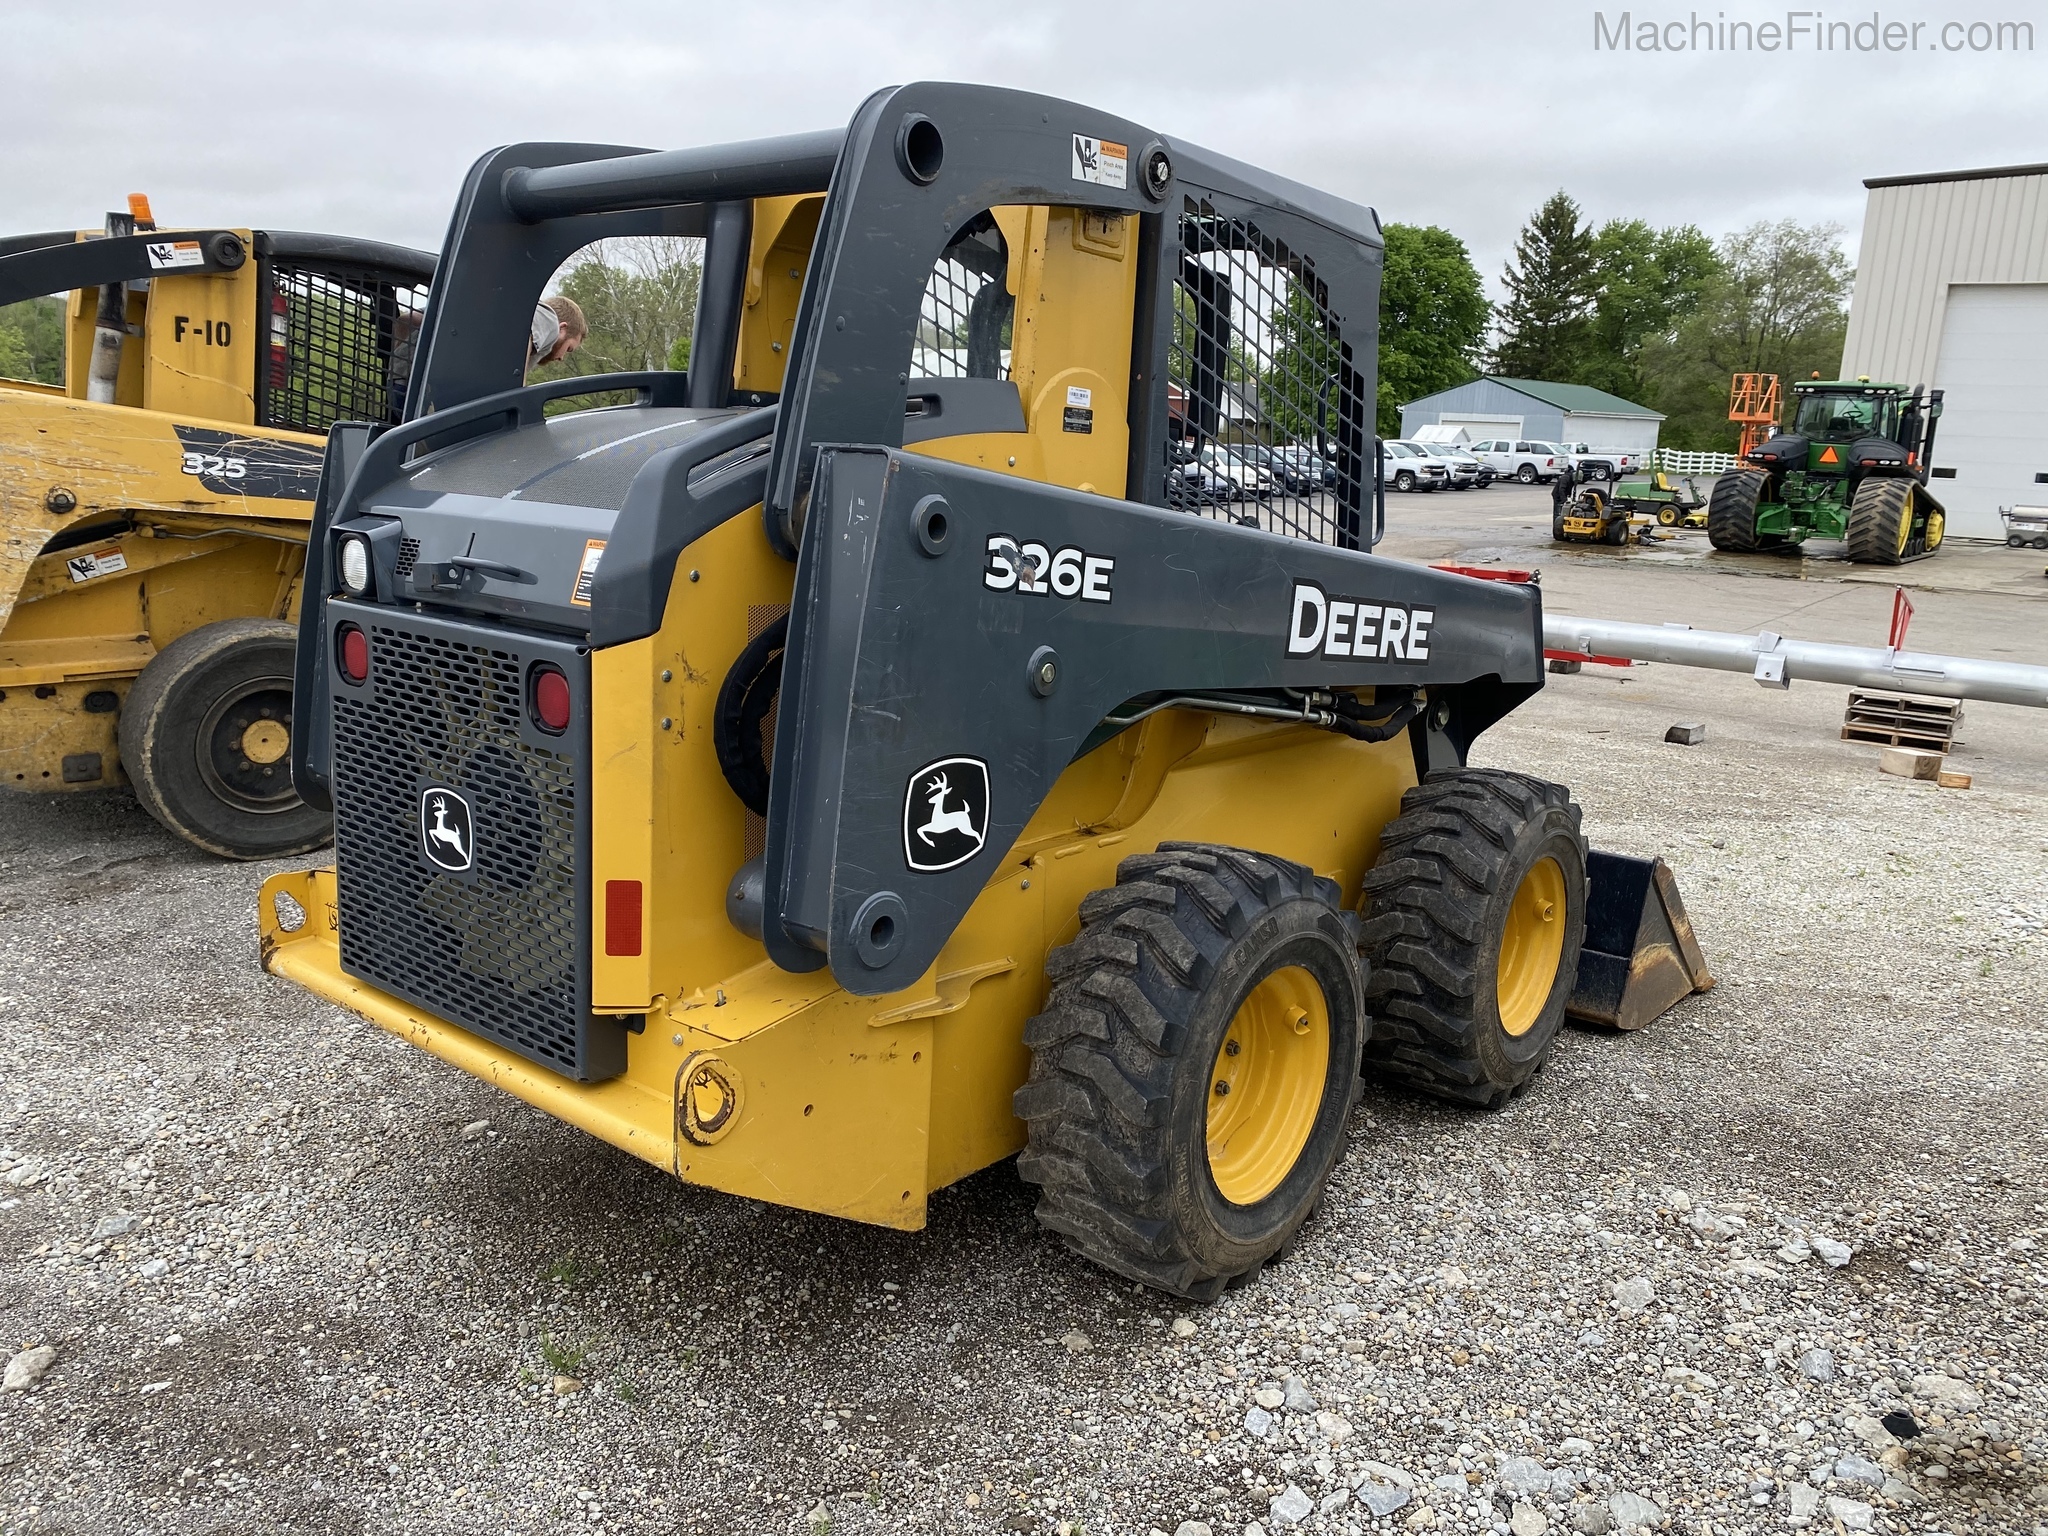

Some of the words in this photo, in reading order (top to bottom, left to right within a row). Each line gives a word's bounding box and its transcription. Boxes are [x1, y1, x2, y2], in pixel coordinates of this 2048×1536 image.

[175, 316, 231, 347] F-10
[182, 452, 247, 479] 325
[984, 535, 1115, 602] 326E
[1288, 584, 1434, 660] DEERE
